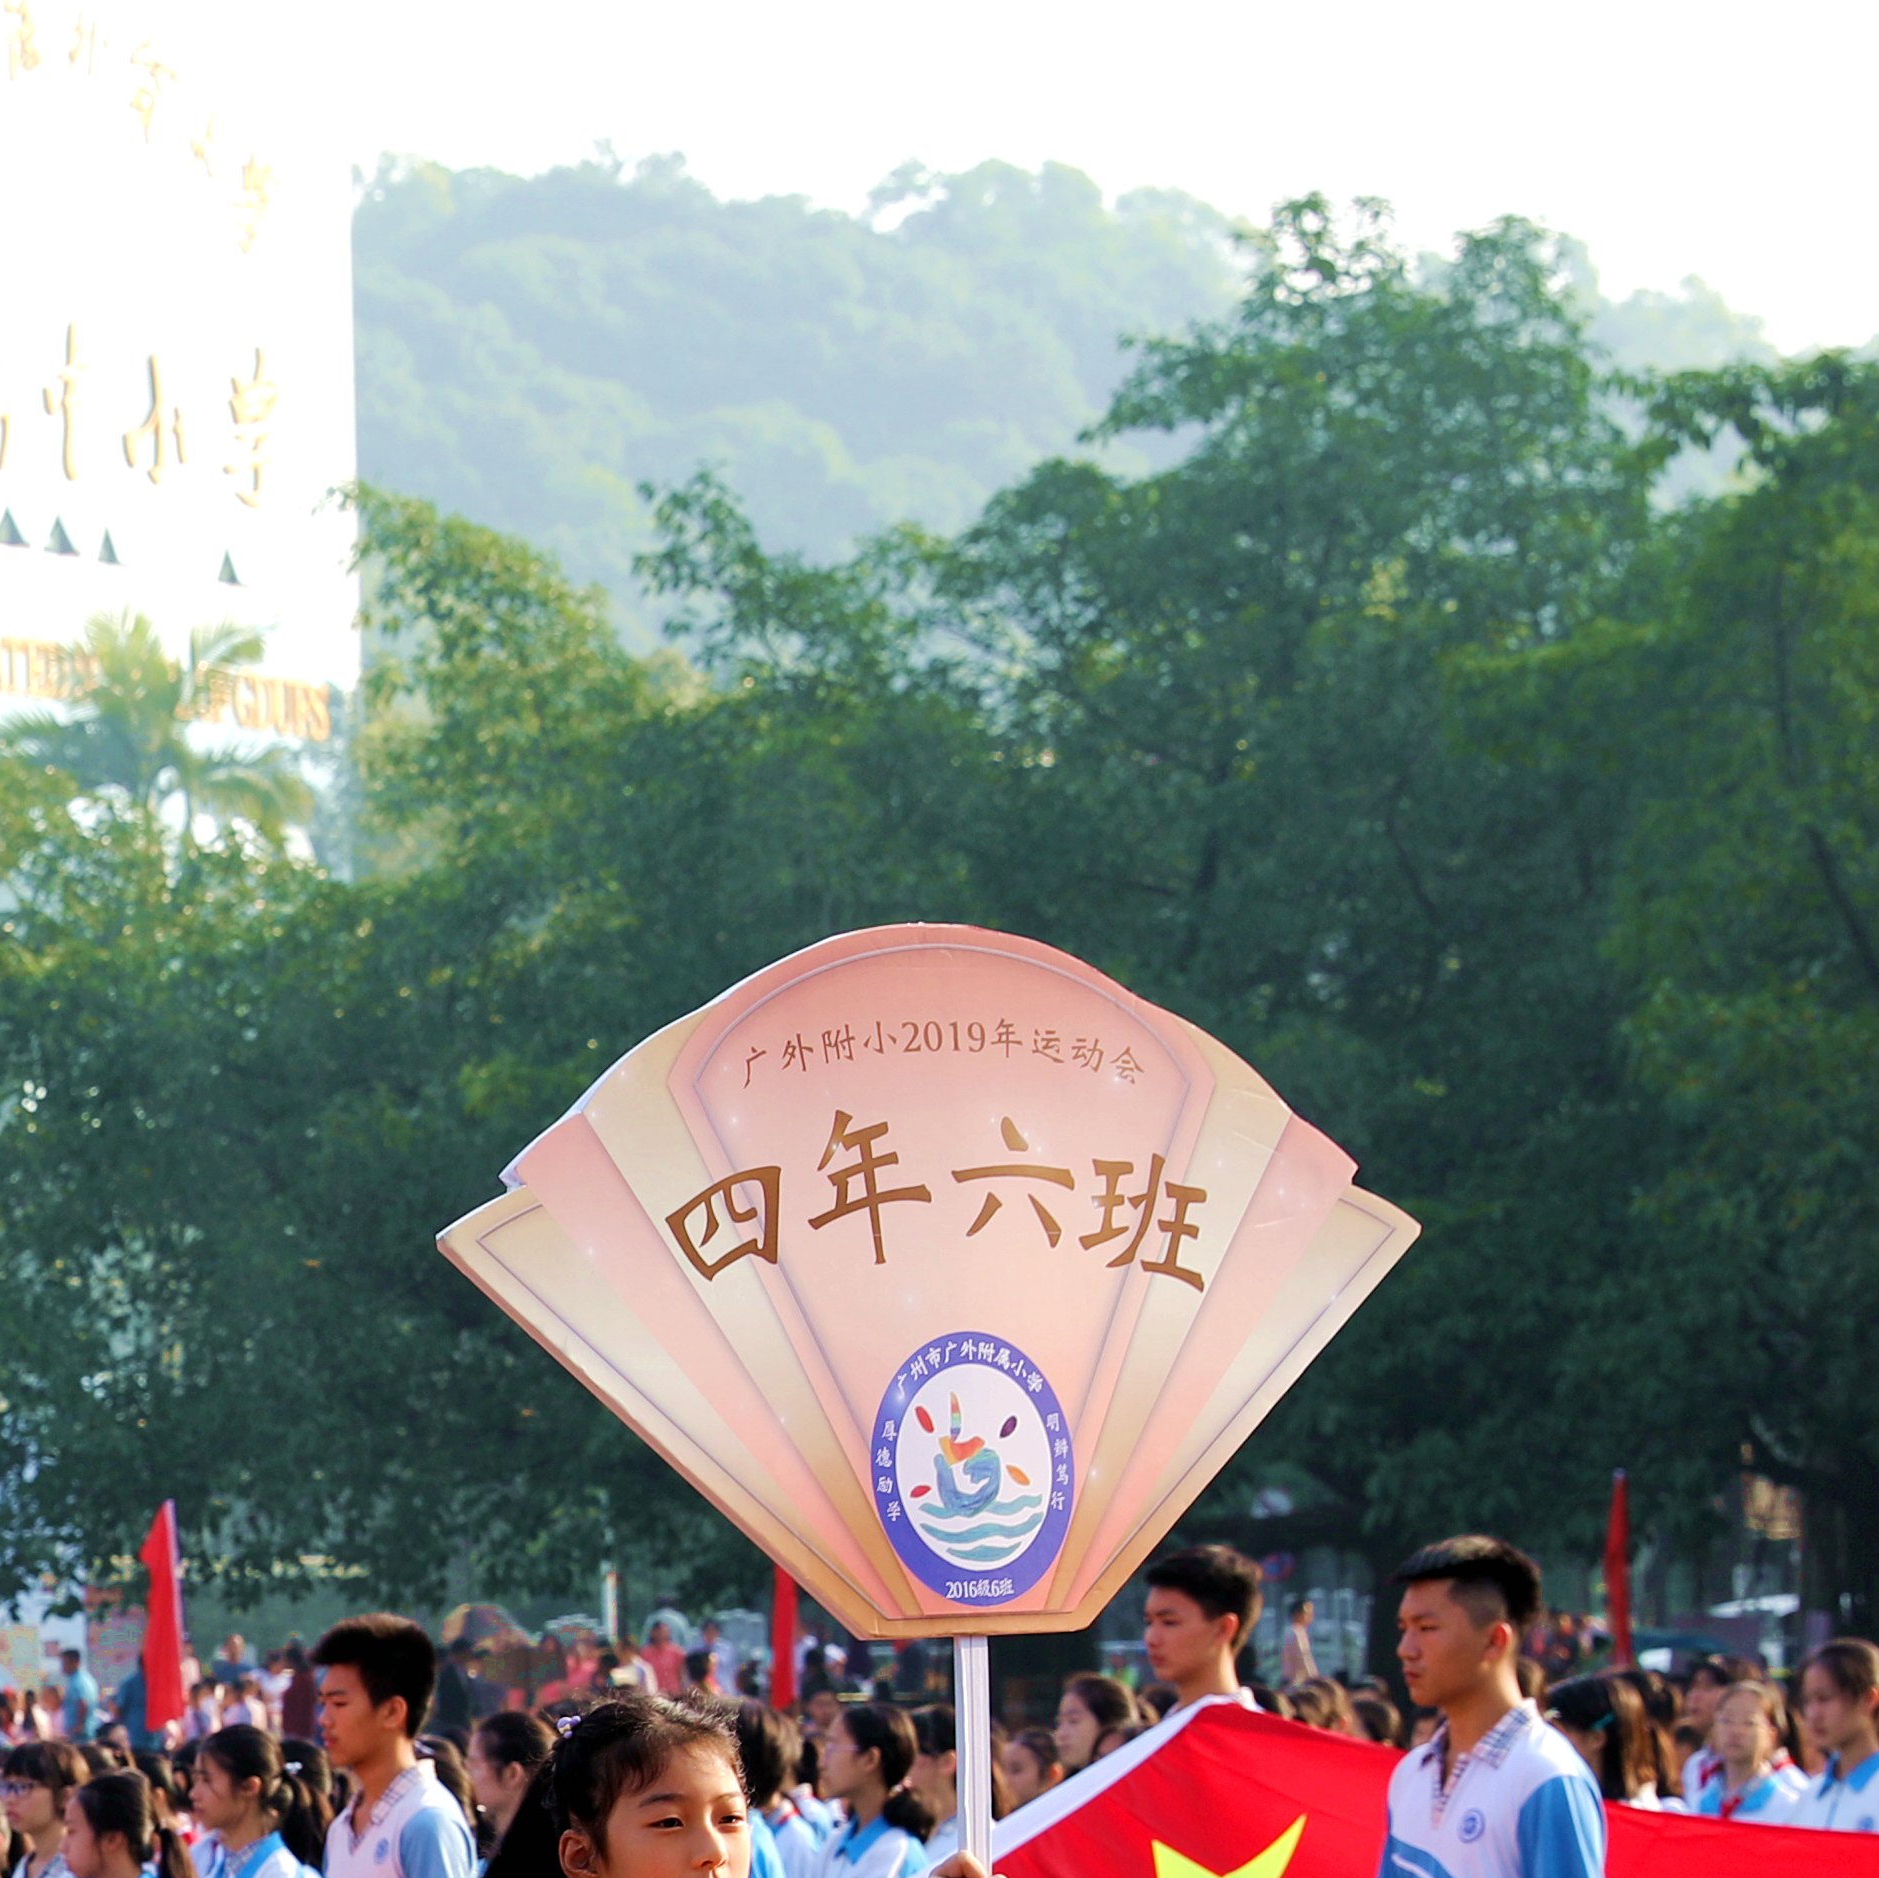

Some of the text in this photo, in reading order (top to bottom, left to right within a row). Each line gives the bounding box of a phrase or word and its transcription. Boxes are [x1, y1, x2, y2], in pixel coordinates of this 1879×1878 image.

[743, 1017, 1145, 1089] 广外附小2019年运动会
[665, 1109, 1207, 1292] 四年六班
[897, 1339, 1044, 1398] 广州市广外附属小学
[946, 1578, 1015, 1600] 2016级6班
